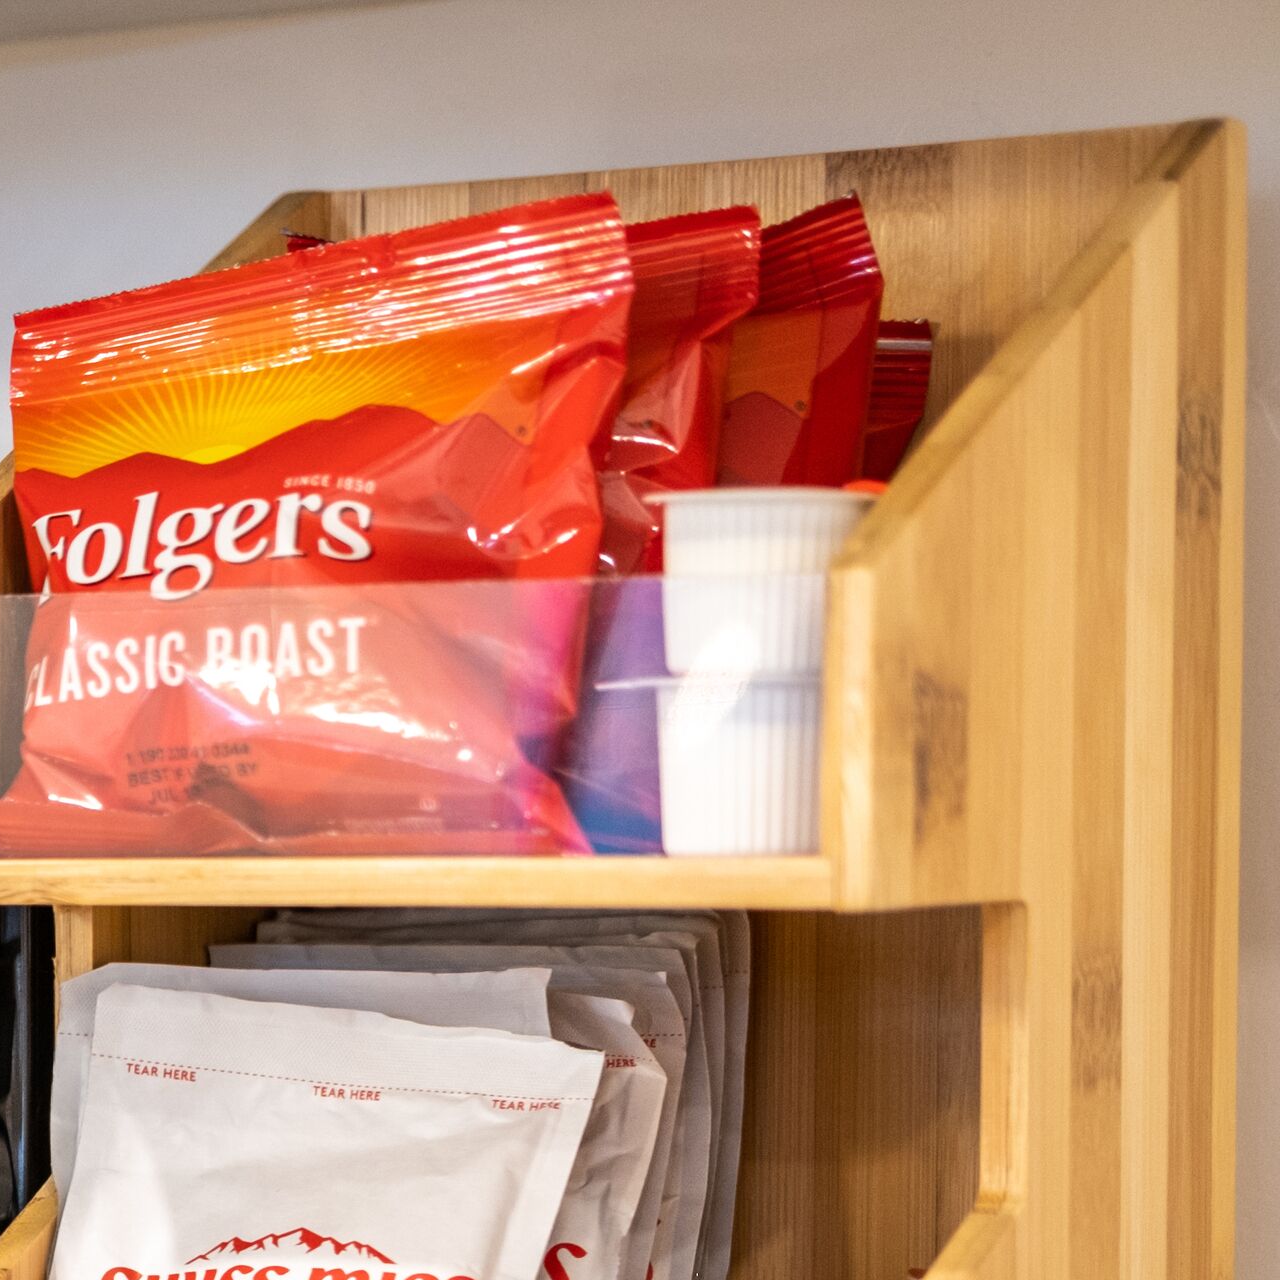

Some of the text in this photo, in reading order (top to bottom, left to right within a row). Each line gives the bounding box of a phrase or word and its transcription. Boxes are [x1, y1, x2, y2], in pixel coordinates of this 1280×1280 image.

[283, 475, 377, 494] SINCE 1850
[31, 490, 374, 606] Folgers
[205, 616, 367, 680] ROAST
[126, 1062, 197, 1082] TEAR HERE
[606, 1058, 637, 1069] HERE
[312, 1085, 381, 1102] TEAR HERE
[491, 1098, 526, 1112] TEAR
